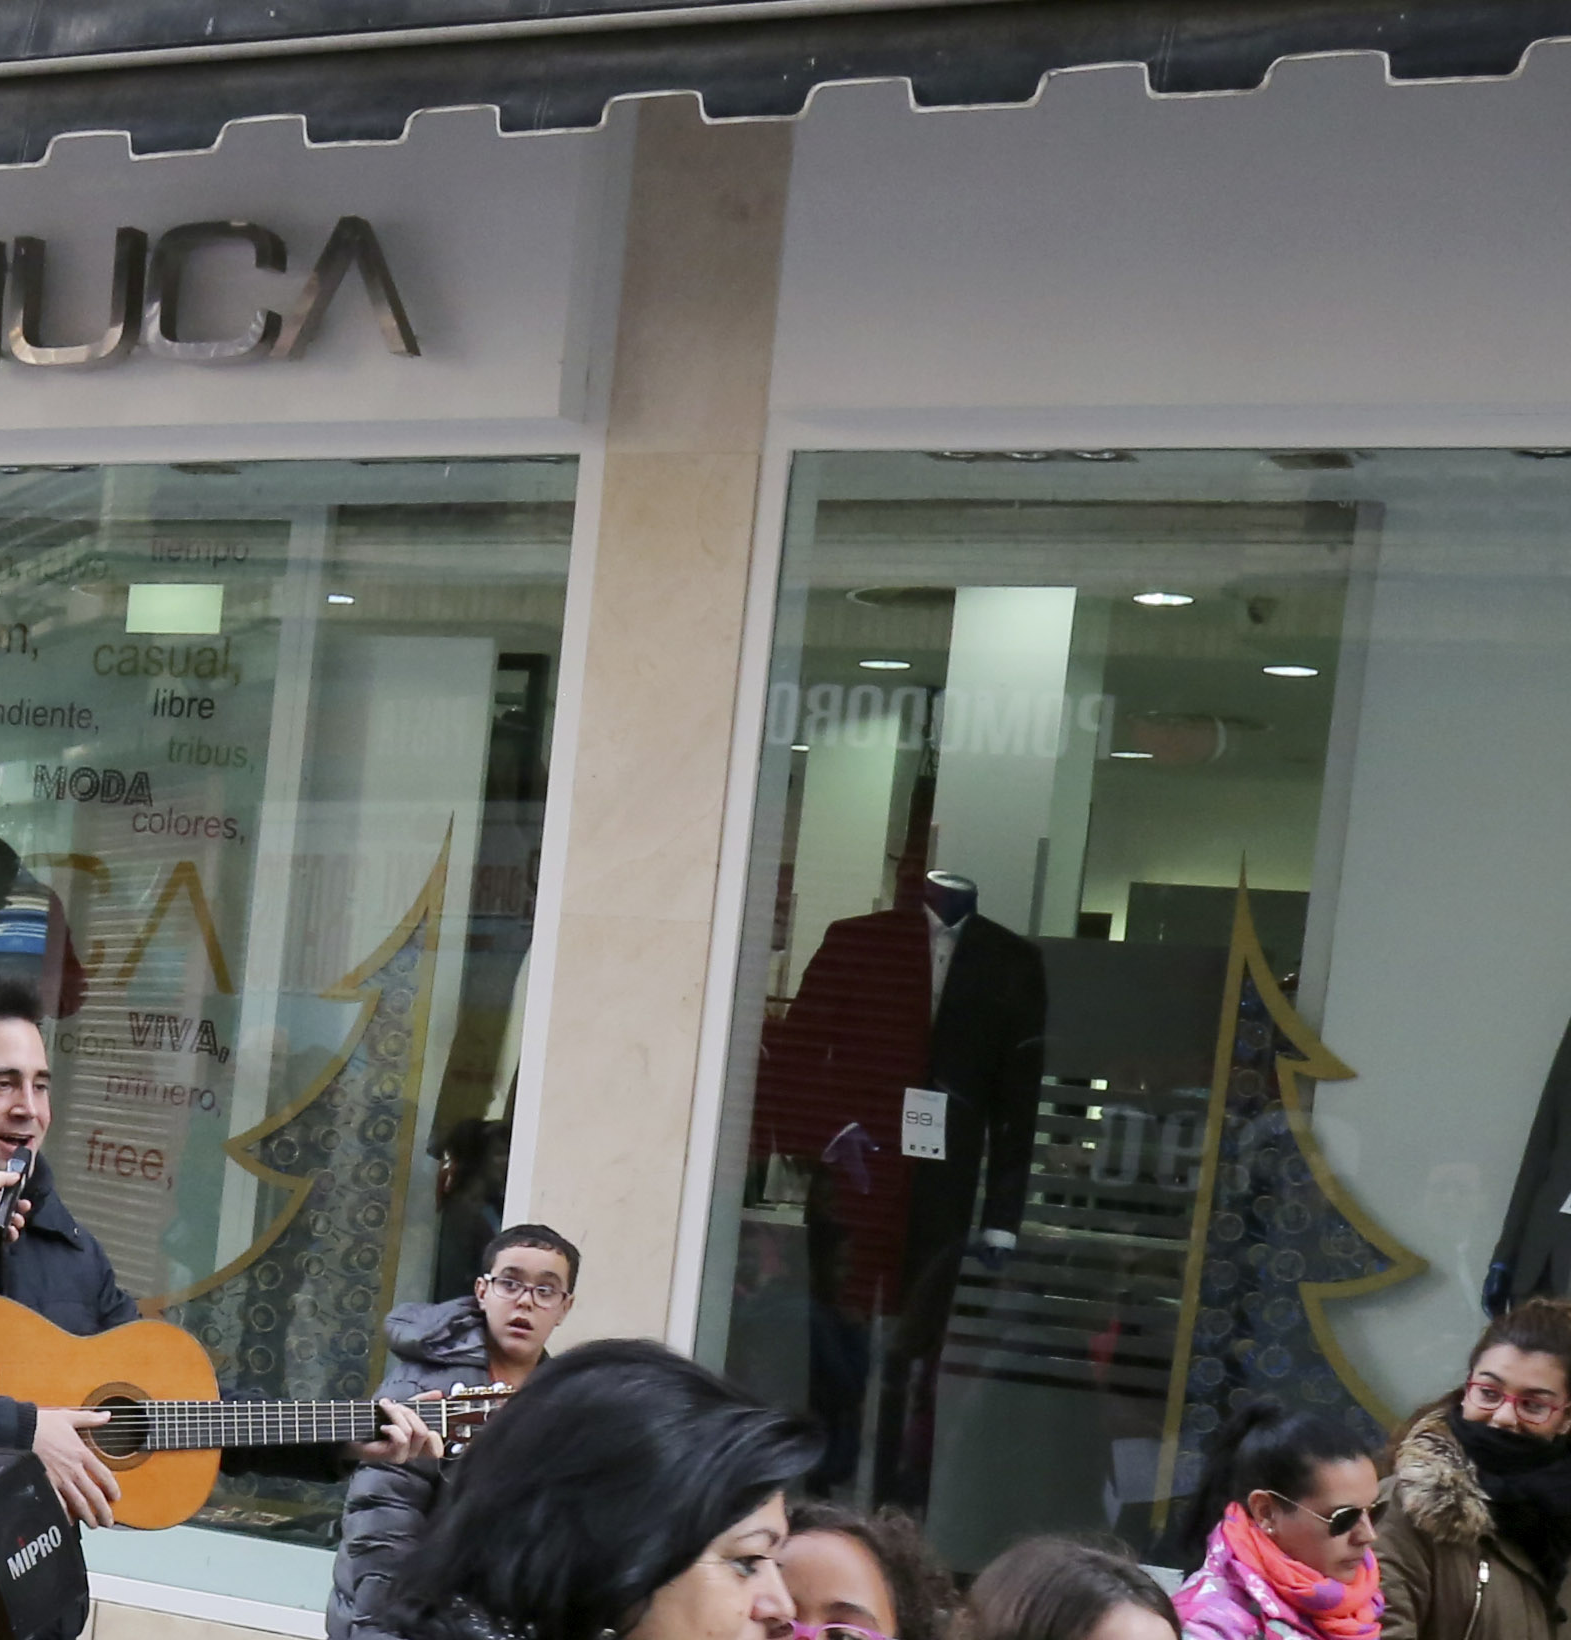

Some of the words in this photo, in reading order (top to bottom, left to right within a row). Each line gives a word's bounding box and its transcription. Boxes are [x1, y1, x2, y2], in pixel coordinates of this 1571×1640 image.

[92, 637, 242, 686] casual,
[152, 688, 216, 720] libre
[167, 736, 256, 773] tribus,
[32, 763, 154, 808] MODA
[132, 808, 246, 845] colores,
[85, 1129, 173, 1191] free,
[6, 1525, 63, 1581] MIPRO
